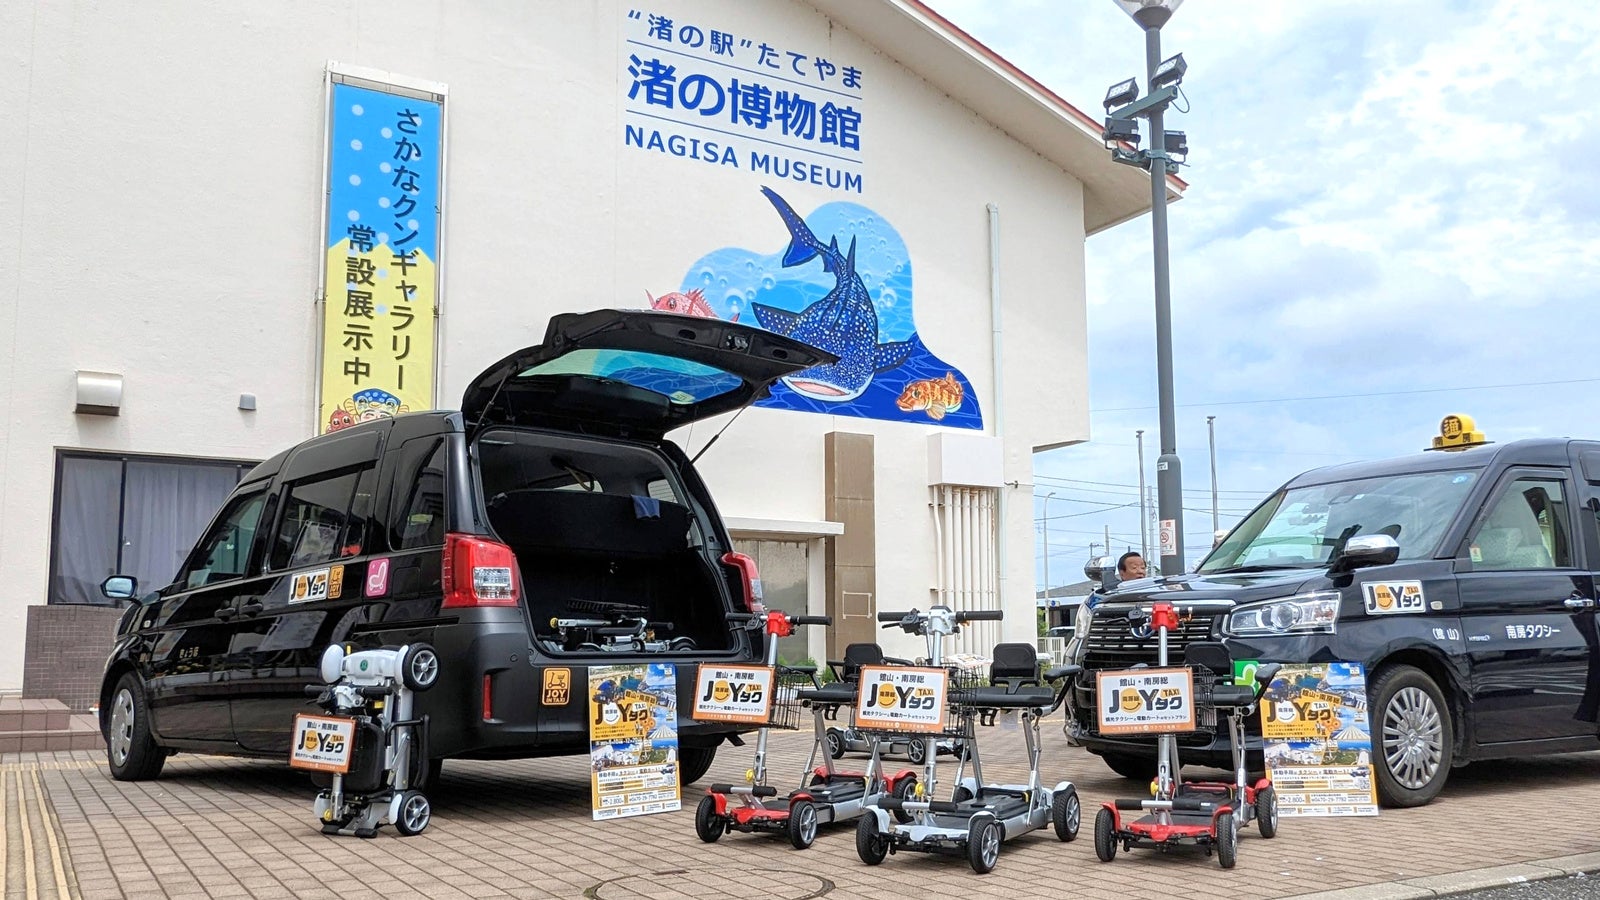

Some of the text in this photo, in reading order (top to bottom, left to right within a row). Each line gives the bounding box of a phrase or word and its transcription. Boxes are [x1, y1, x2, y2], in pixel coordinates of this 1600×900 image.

[627, 54, 862, 151] 渚の博物館
[625, 124, 862, 194] NAGISA MUSEUM
[390, 108, 422, 389] さかなクンギャラリー
[342, 224, 376, 385] 常設展示中
[1505, 624, 1561, 640] 南房タクシー
[879, 673, 925, 684] 館山・南房総
[1119, 676, 1169, 687] 館山・南房総
[546, 689, 566, 698] JOY
[748, 684, 762, 692] TAXI
[918, 688, 934, 696] TAXI
[1163, 688, 1180, 697] TAXI
